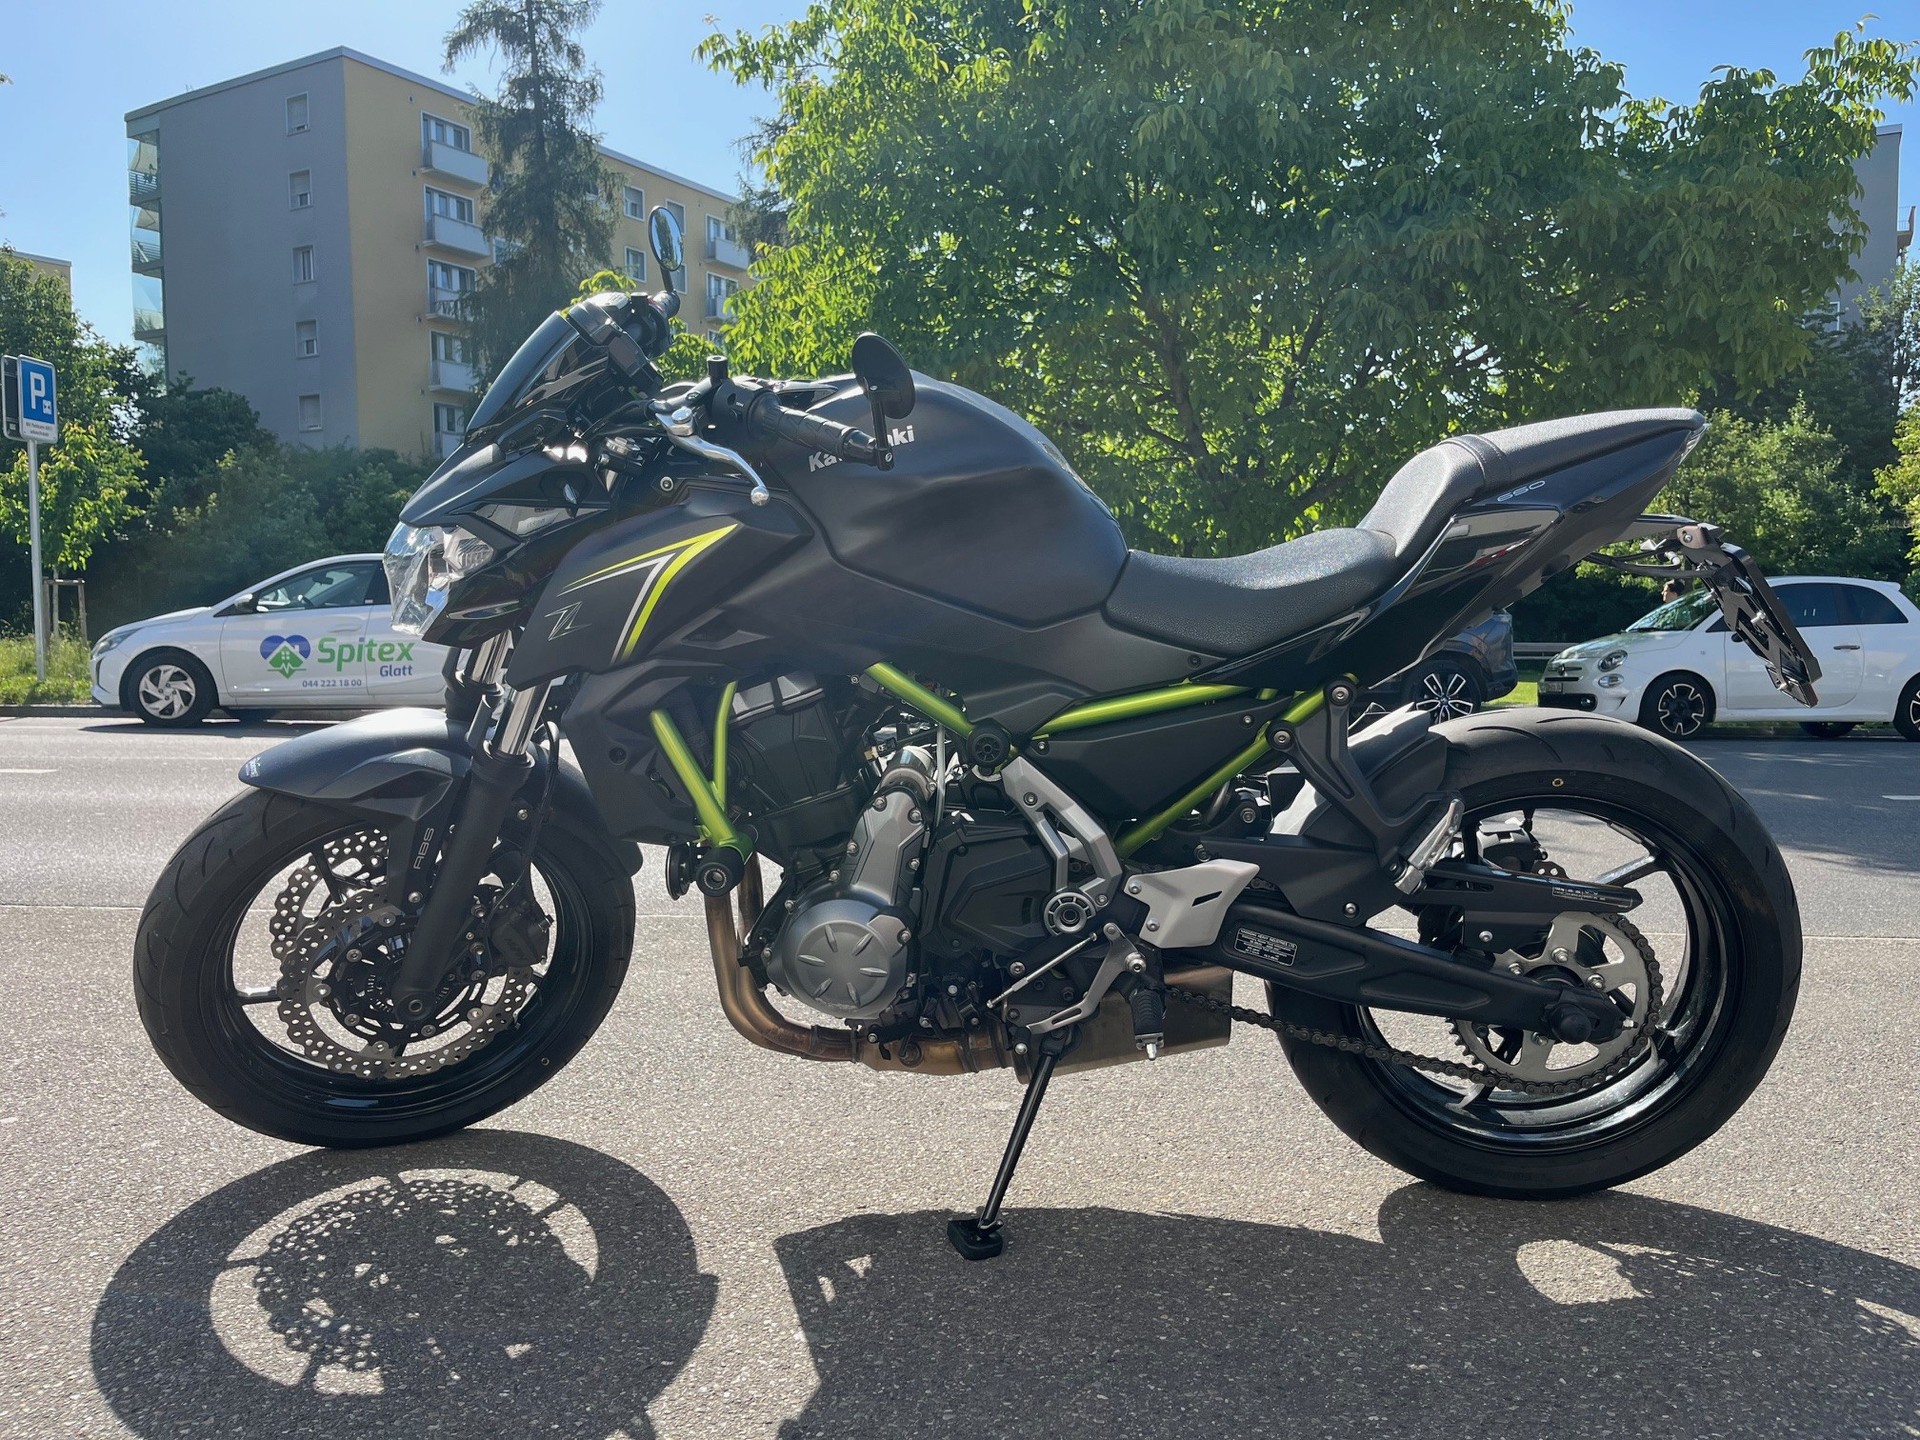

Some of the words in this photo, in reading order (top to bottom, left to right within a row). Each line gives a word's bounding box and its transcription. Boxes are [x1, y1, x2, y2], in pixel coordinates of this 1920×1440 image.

[29, 371, 46, 410] P
[808, 425, 915, 473] Kaki
[1497, 480, 1546, 502] 650
[317, 637, 415, 672] Spitex
[379, 664, 413, 678] Glatt
[302, 679, 320, 688] 044
[320, 679, 337, 688] 222
[339, 679, 350, 687] 18
[351, 679, 362, 687] 00
[413, 827, 435, 870] ABS
